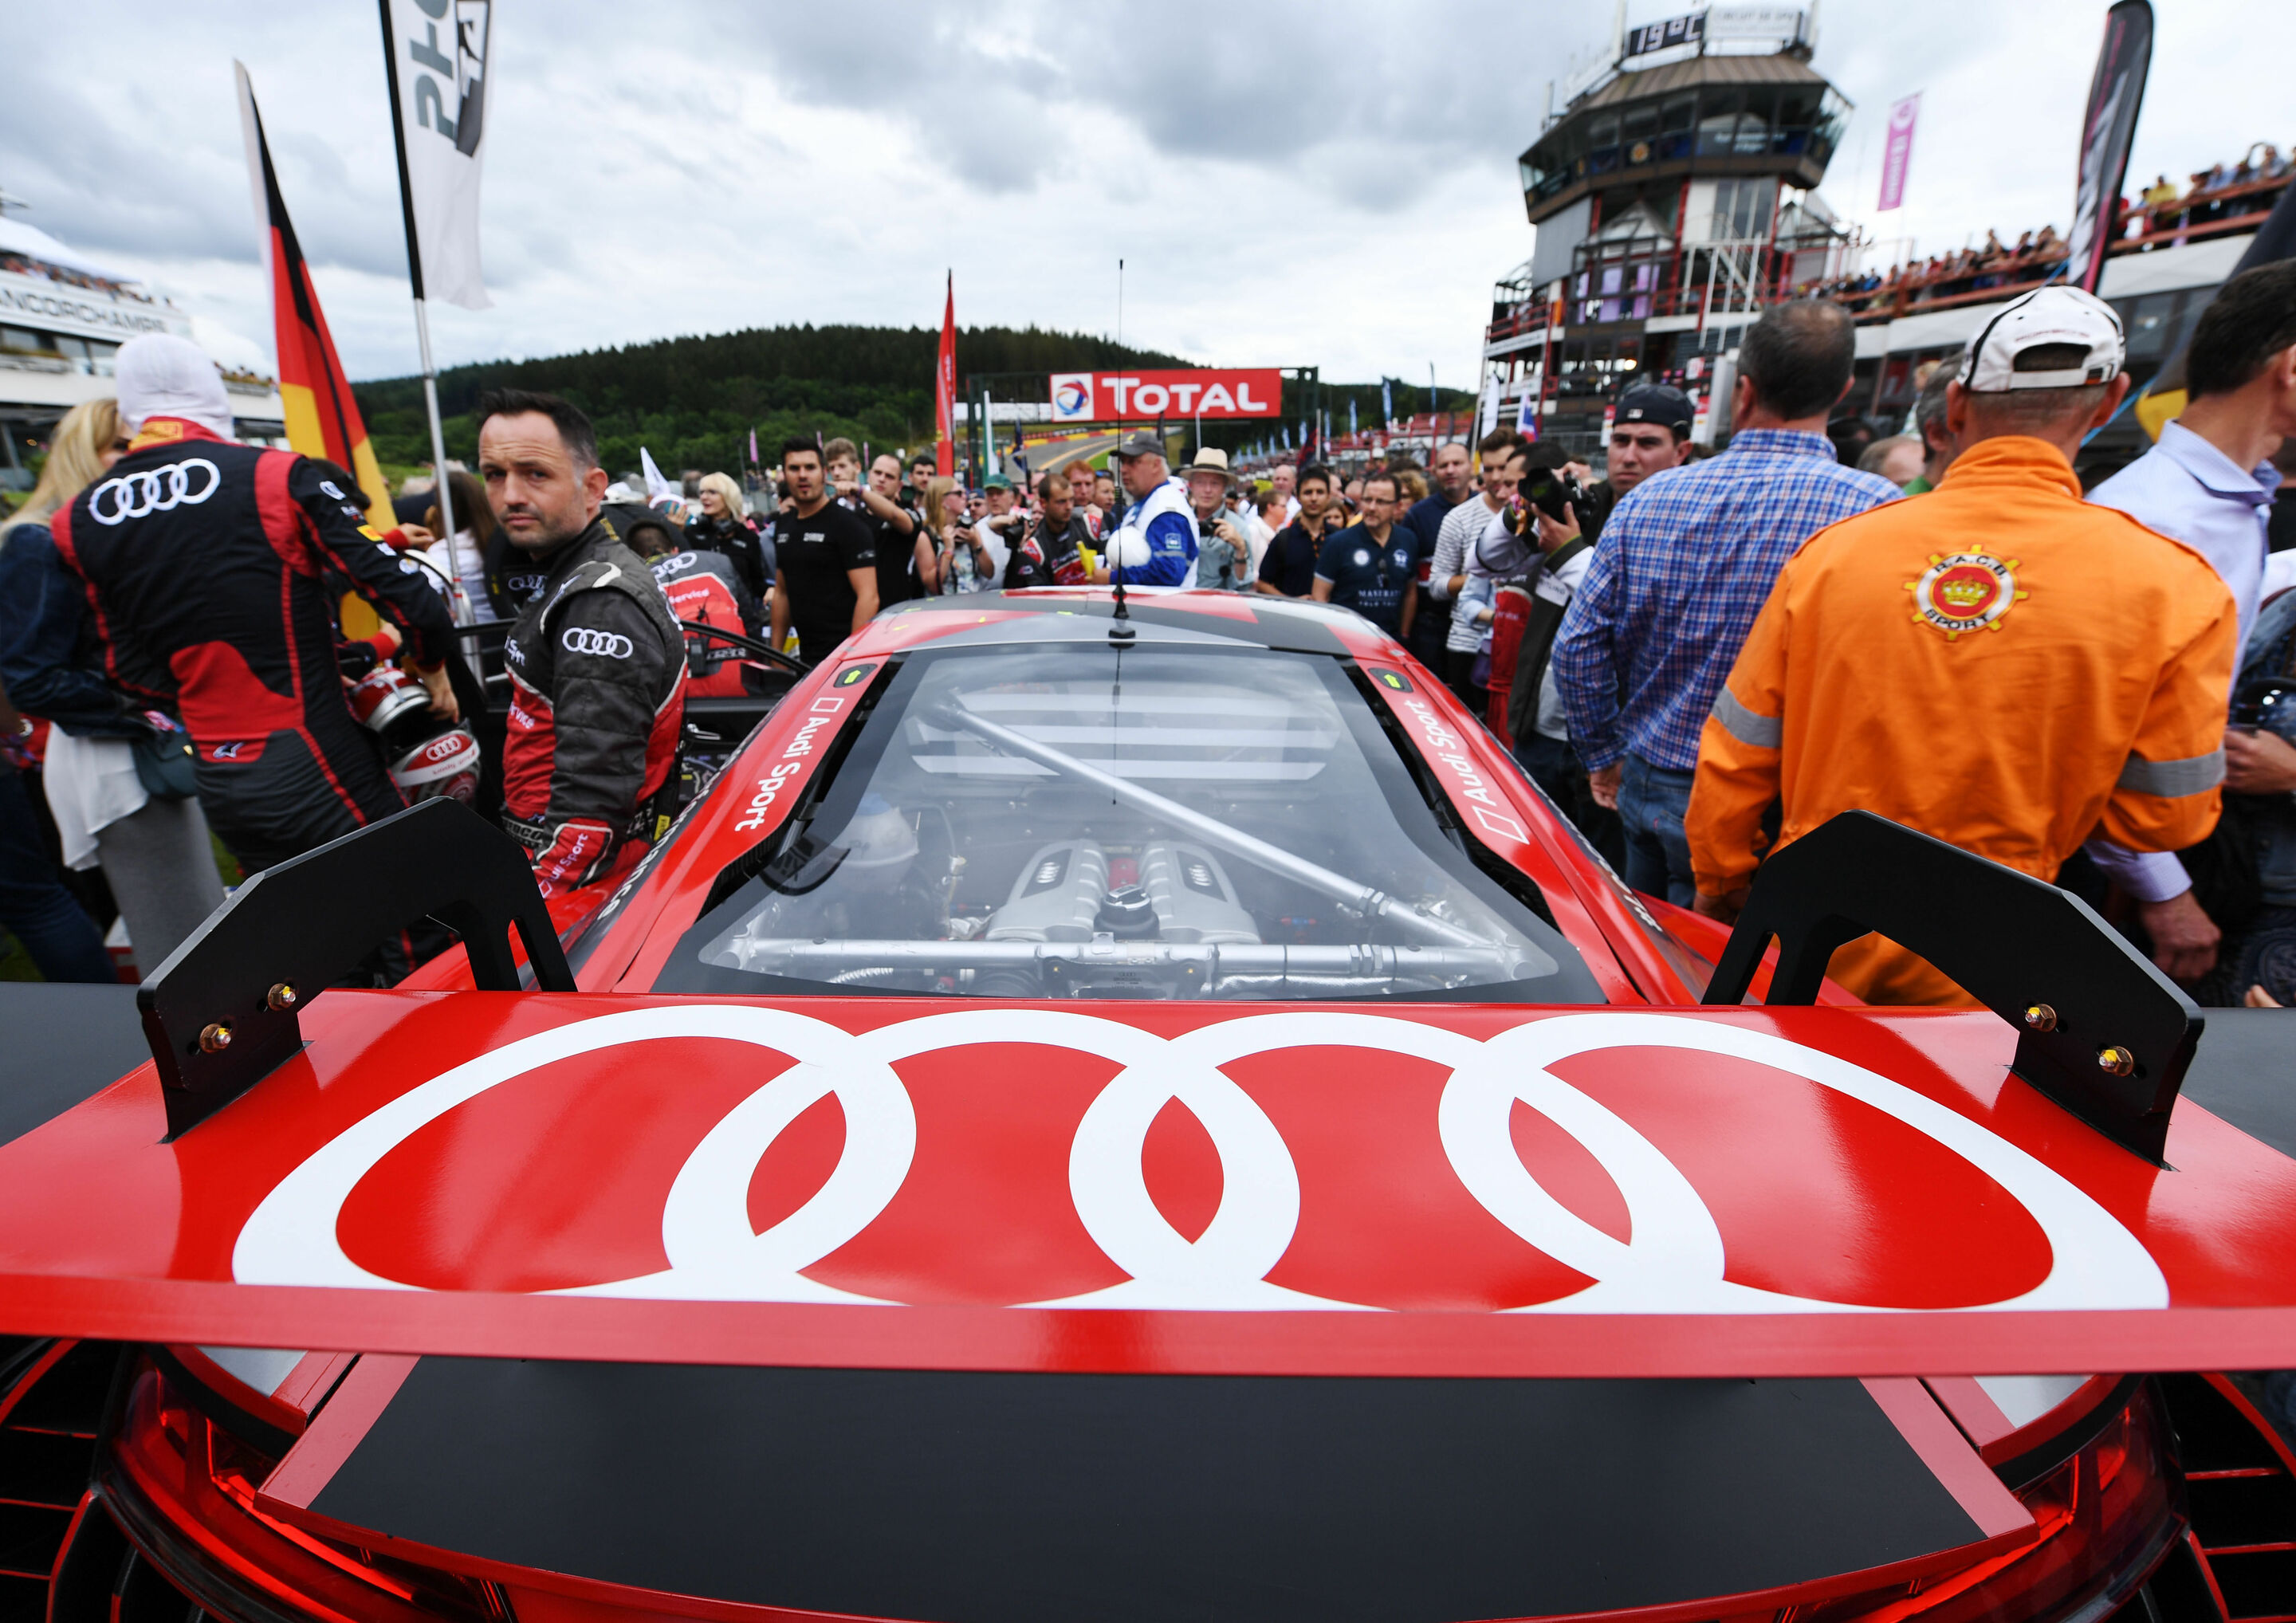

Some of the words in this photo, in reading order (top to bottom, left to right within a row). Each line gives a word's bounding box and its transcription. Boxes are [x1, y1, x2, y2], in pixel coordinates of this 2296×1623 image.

[1101, 376, 1268, 415] TOTAL
[1925, 608, 1991, 630] SPORT
[782, 717, 830, 758] Audi
[1404, 700, 1457, 754] Sport
[734, 762, 801, 832] Sport
[1438, 752, 1496, 807] Audi
[560, 833, 589, 867] Sport
